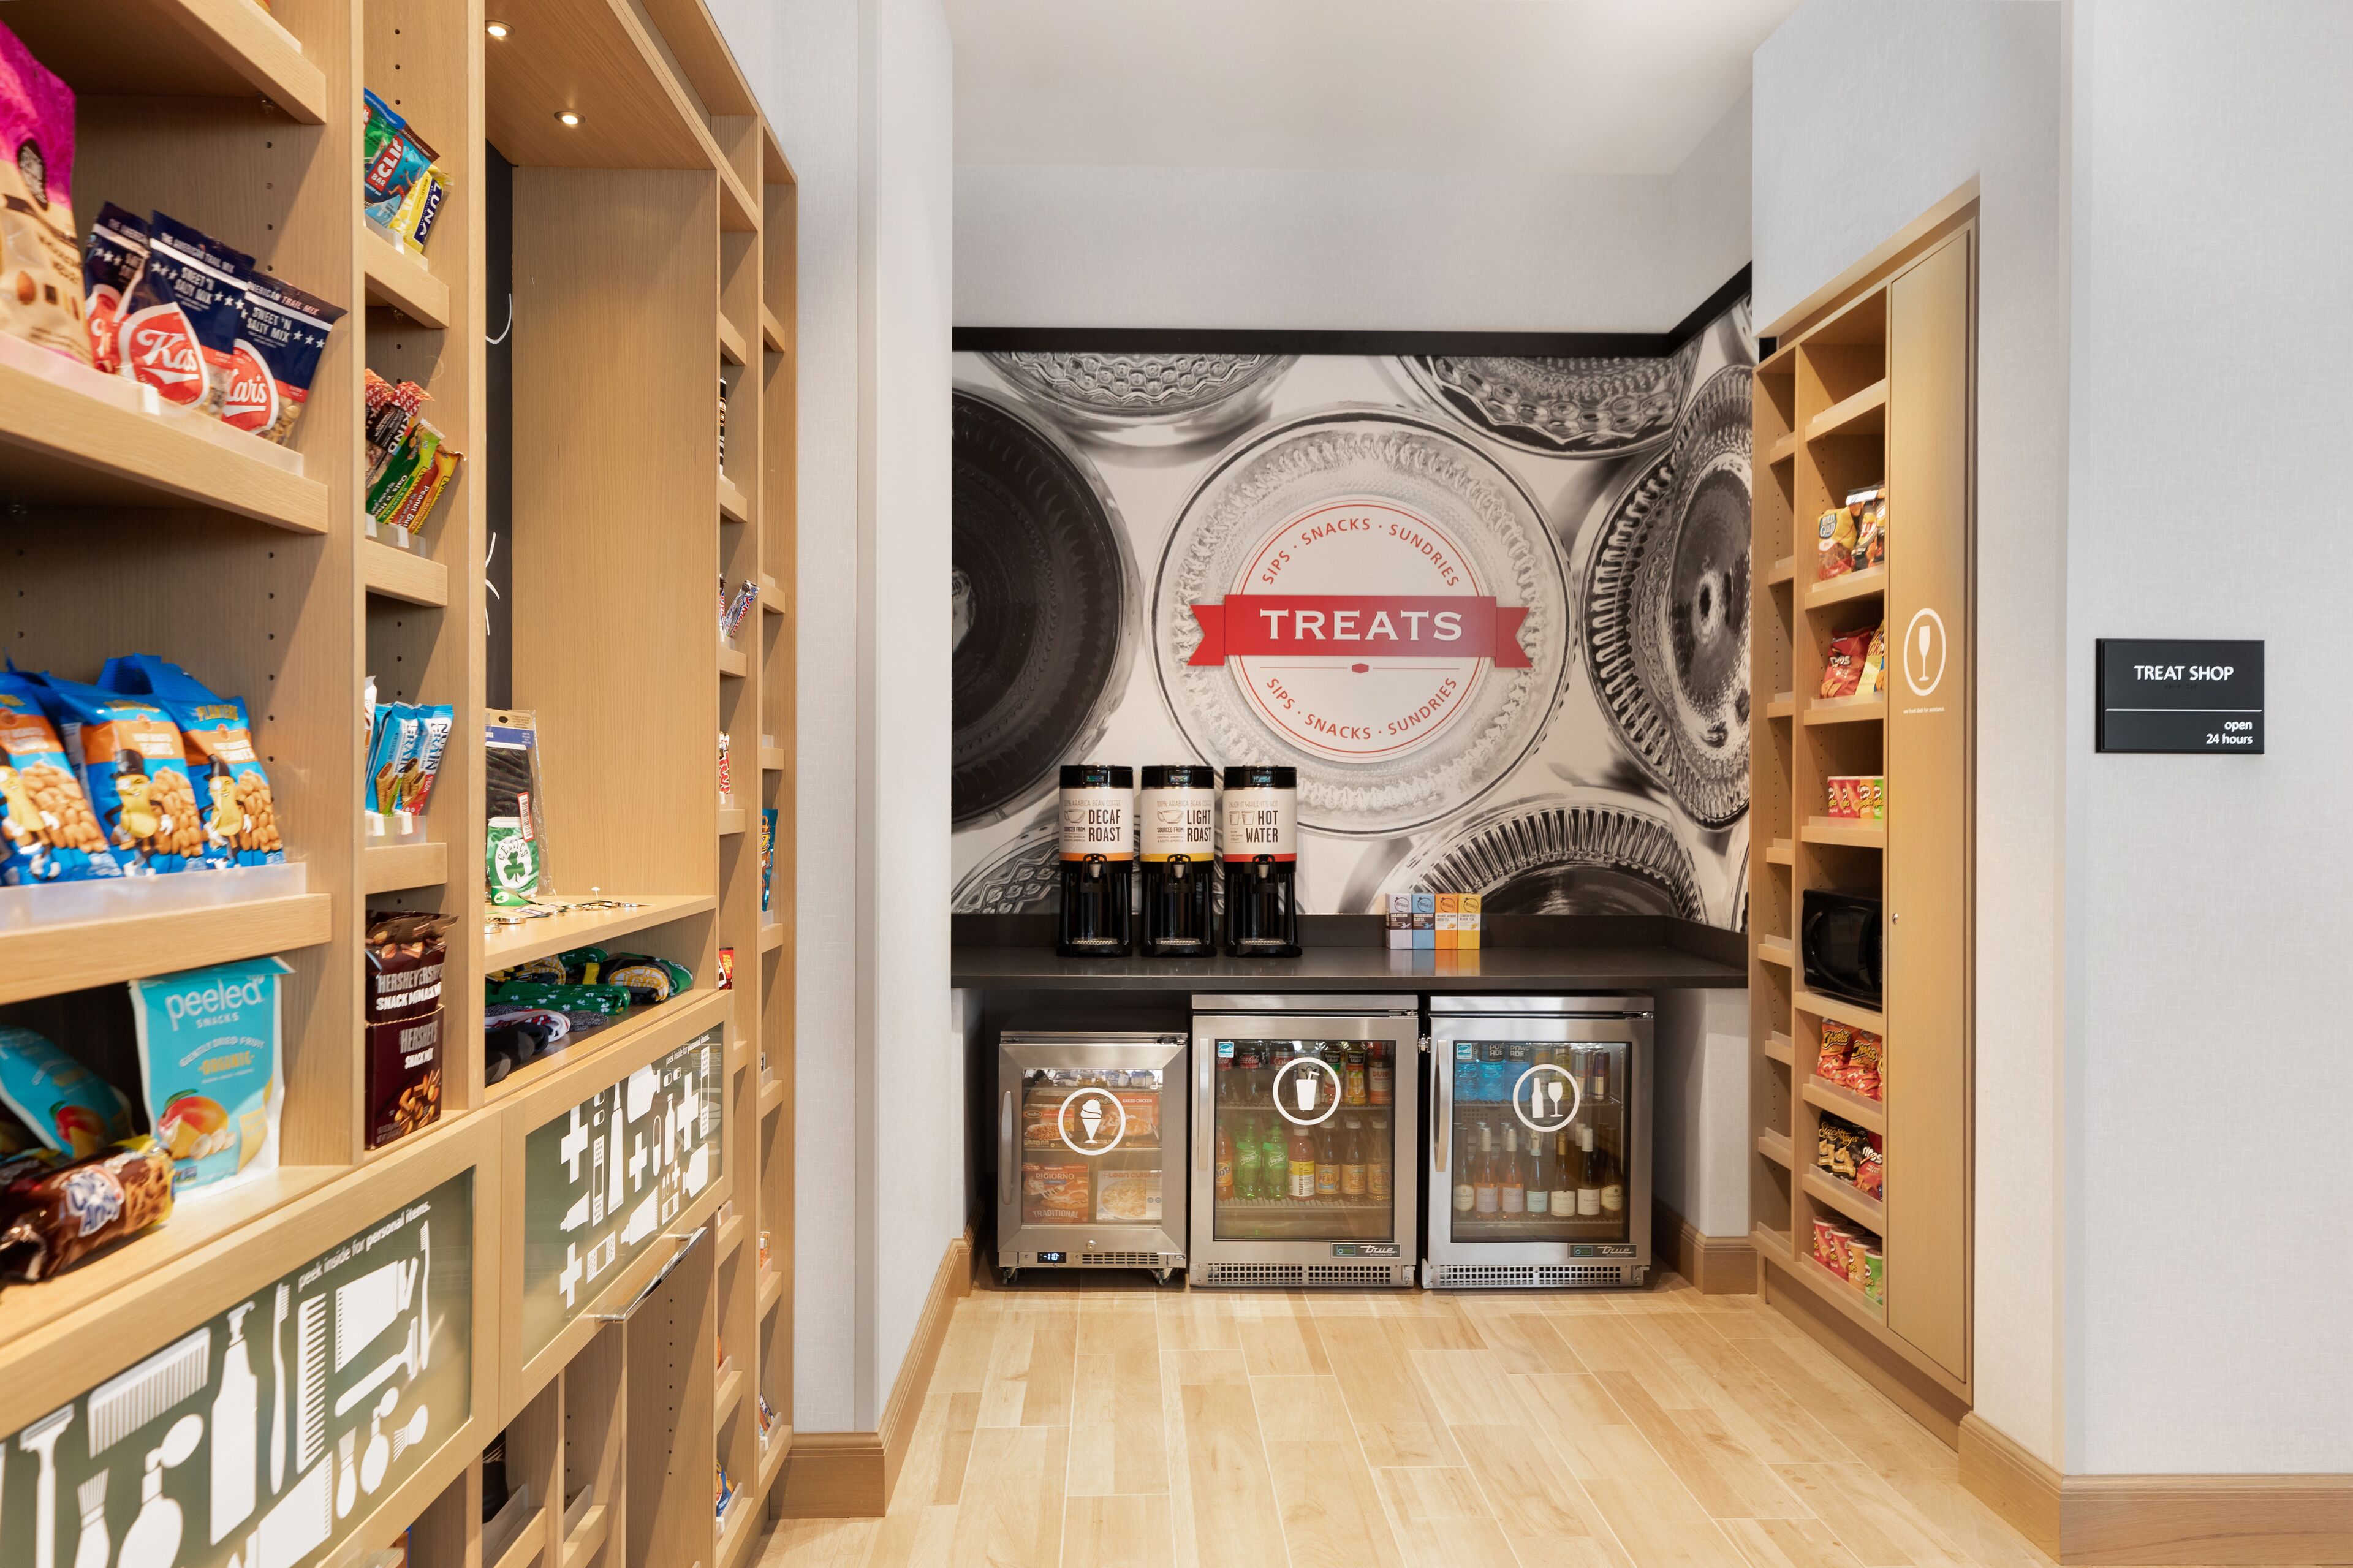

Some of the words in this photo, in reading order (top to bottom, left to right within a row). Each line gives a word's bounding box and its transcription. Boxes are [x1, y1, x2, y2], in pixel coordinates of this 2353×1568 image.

[377, 138, 402, 178] CLIF
[371, 173, 386, 186] BAR
[420, 182, 441, 236] LUNA
[281, 296, 303, 309] TRAIL
[302, 305, 320, 316] MIX
[252, 306, 279, 326] SWEET
[247, 318, 270, 335] SALTY
[270, 327, 292, 343] MIX
[388, 412, 411, 453] KIND
[392, 475, 407, 492] Oats
[411, 485, 430, 512] Peanut
[1262, 550, 1290, 585] SIPS
[1301, 518, 1371, 546] SNACKS
[1389, 524, 1459, 587] SUNDRIES
[1259, 608, 1463, 642] TREATS
[2134, 665, 2185, 681] TREAT
[2189, 665, 2234, 681] SHOP
[1267, 678, 1292, 710] SIPS
[1305, 713, 1371, 740] SNACKS
[1388, 677, 1457, 735] SUNDRIES
[2224, 721, 2253, 732] open
[2206, 733, 2220, 744] 24
[2222, 733, 2253, 744] hours
[1088, 809, 1121, 824] DECAF
[1187, 809, 1211, 825] LIGHT
[1258, 811, 1278, 825] HOT
[1088, 827, 1121, 842] ROAST
[1187, 827, 1211, 842] ROAST
[1246, 828, 1278, 843] WATER
[498, 839, 528, 861] CELTICS
[165, 978, 265, 1032] peeled
[376, 992, 409, 1011] SNACK
[195, 1012, 240, 1029] SNACKS
[240, 1037, 265, 1049] FRUIT
[404, 1051, 424, 1069] SNACK
[1033, 1209, 1080, 1219] TRADITIONAL
[298, 1260, 323, 1293] peek
[324, 1246, 352, 1274] inside
[351, 1238, 366, 1256] for
[366, 1211, 405, 1252] personal
[1360, 1244, 1396, 1254] true
[1597, 1245, 1632, 1254] true
